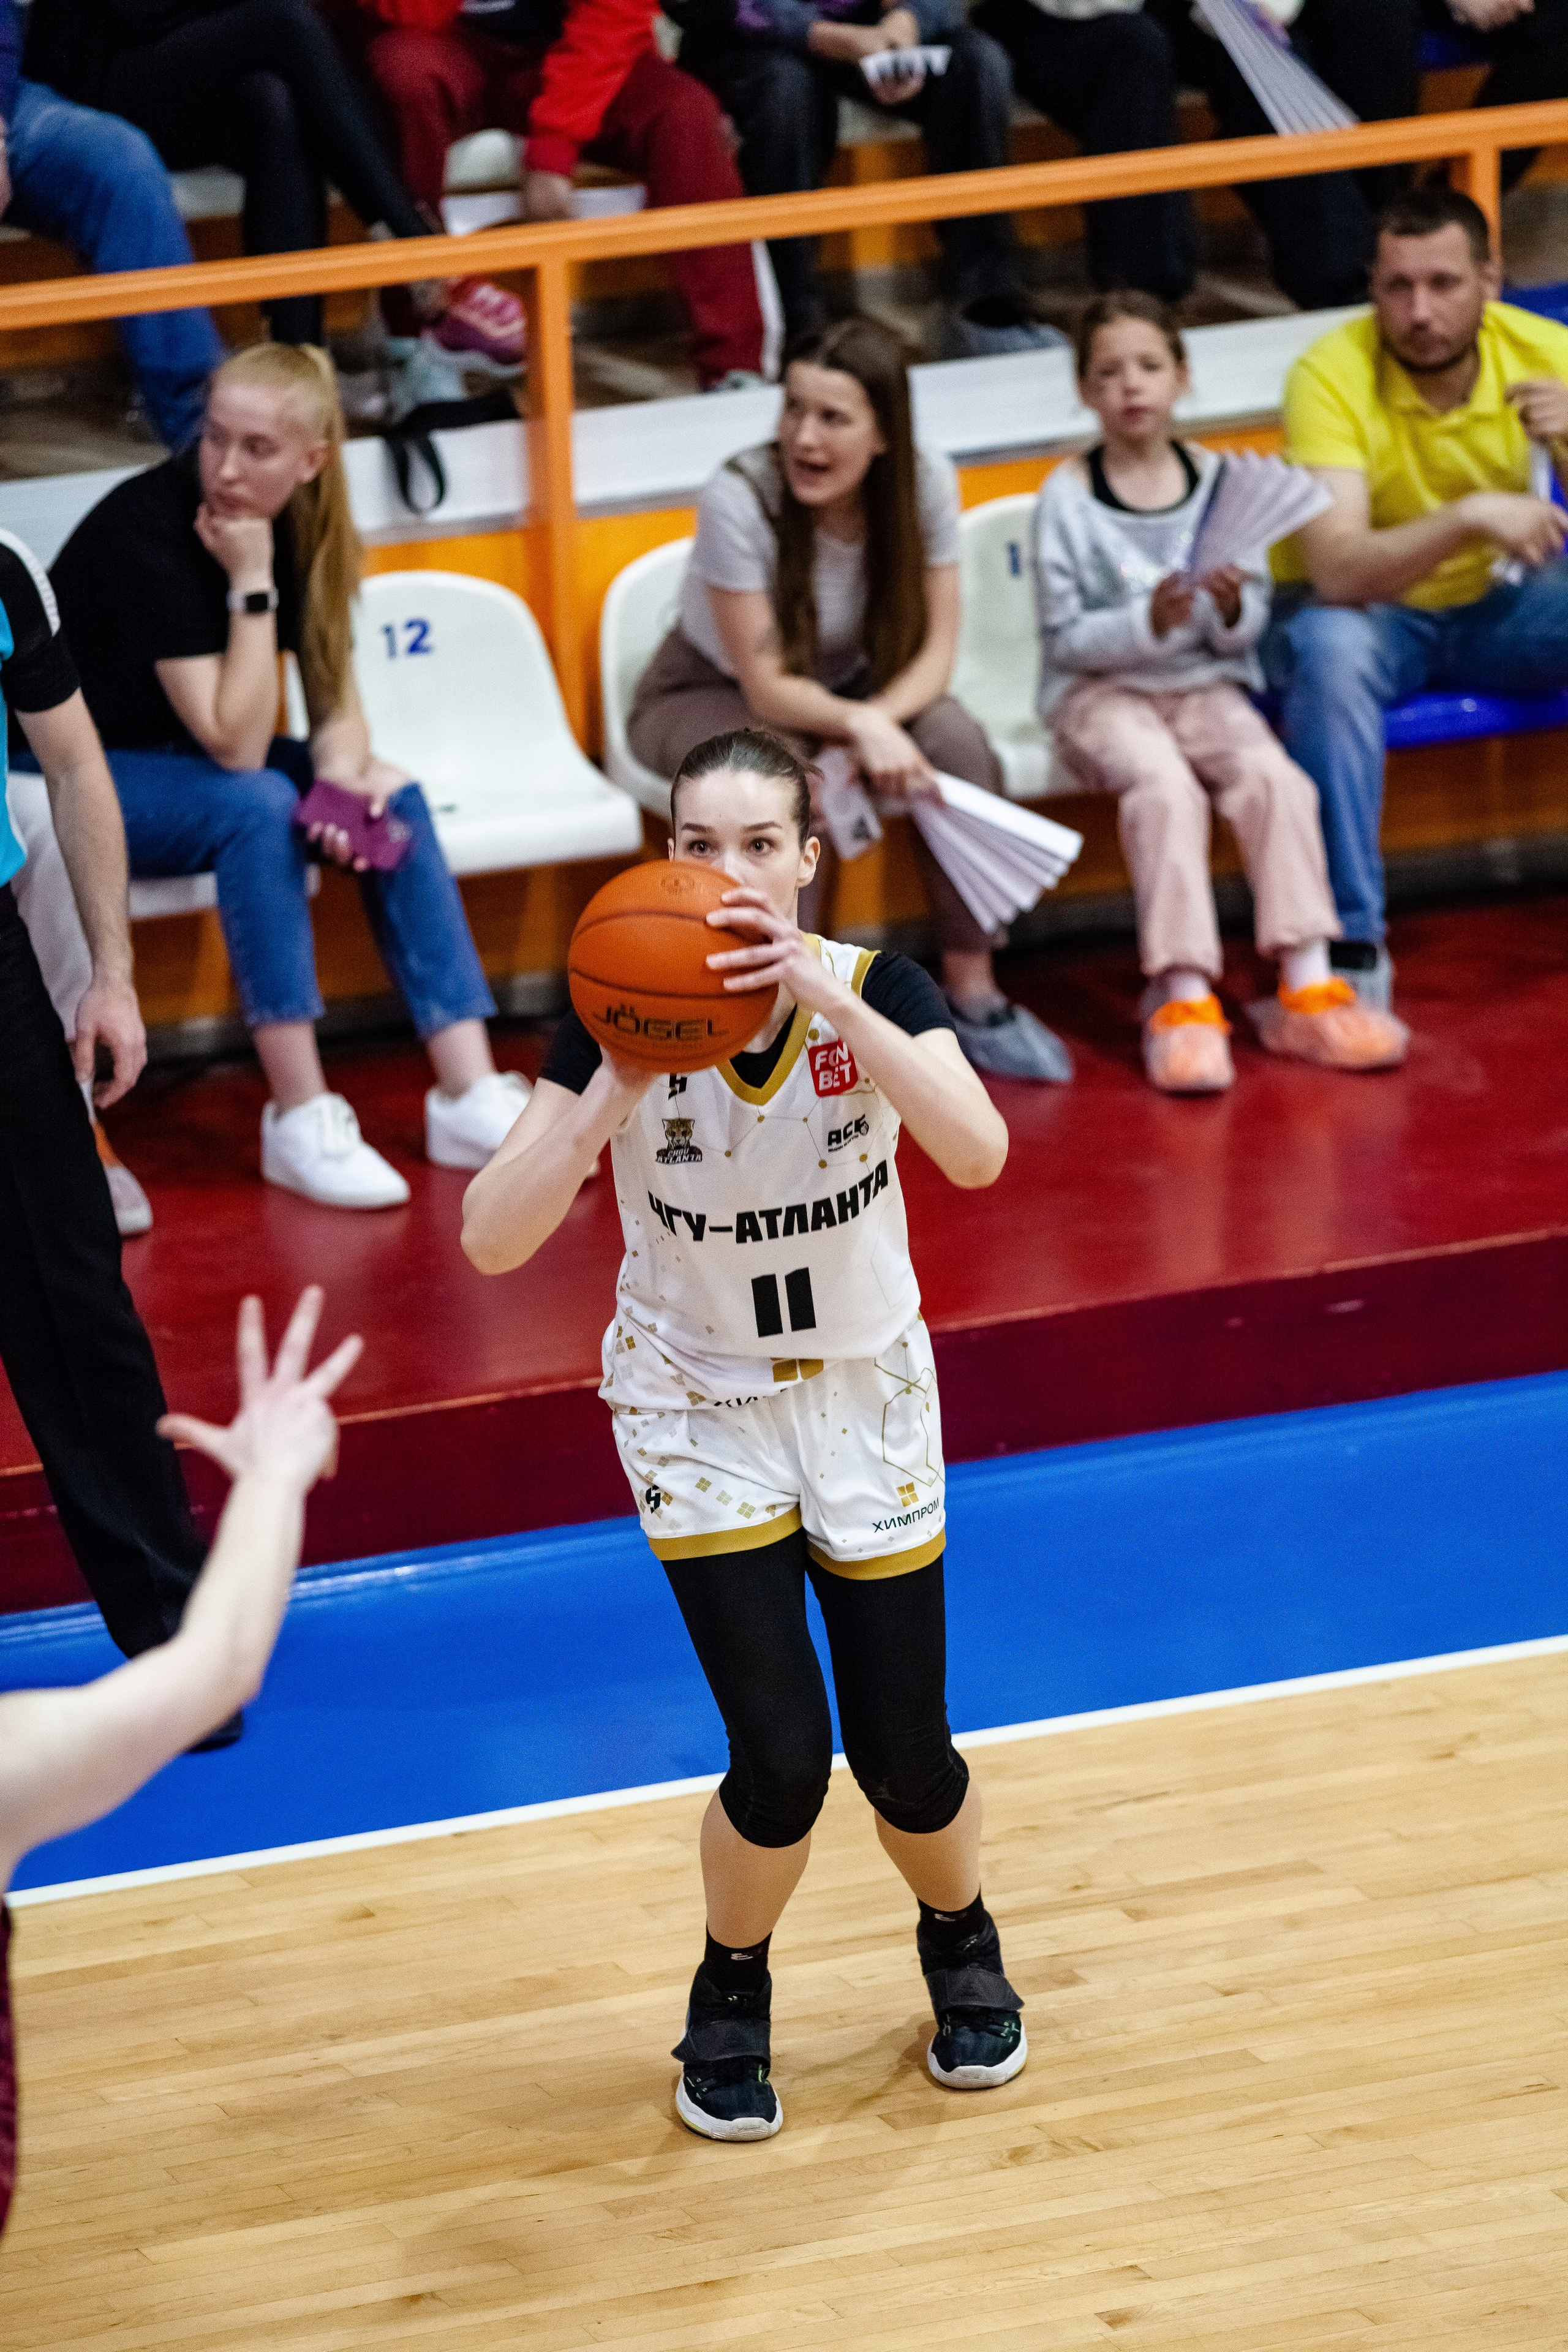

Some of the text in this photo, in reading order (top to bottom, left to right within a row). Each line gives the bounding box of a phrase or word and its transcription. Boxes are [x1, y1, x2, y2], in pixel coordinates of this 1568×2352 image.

[380, 617, 434, 660] 12
[592, 1005, 730, 1041] JÖGEL
[657, 1153, 701, 1164] ATLANTA
[751, 1267, 816, 1338] 11
[872, 1496, 940, 1533] ХИМПРОМ
